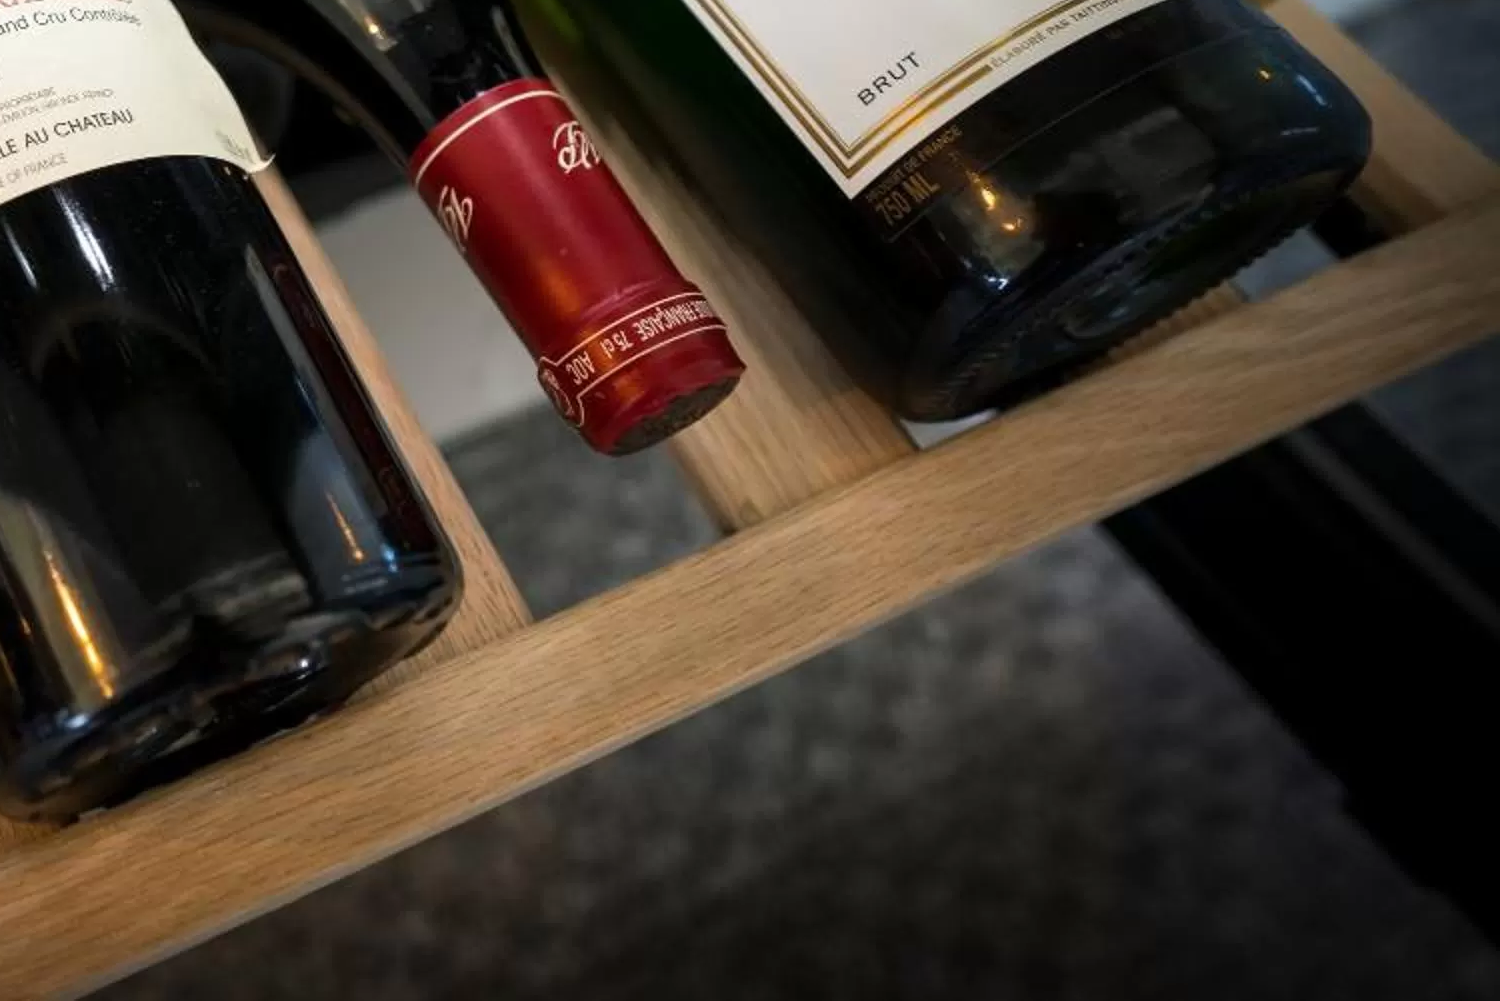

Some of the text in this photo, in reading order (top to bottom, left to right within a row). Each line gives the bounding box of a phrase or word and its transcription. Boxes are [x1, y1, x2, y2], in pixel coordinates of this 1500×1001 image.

[33, 9, 67, 26] Cru
[857, 51, 920, 106] BRUT
[25, 128, 50, 149] AU
[54, 108, 134, 138] CHATEAU
[874, 172, 941, 227] 750 ML
[565, 350, 595, 386] AOC
